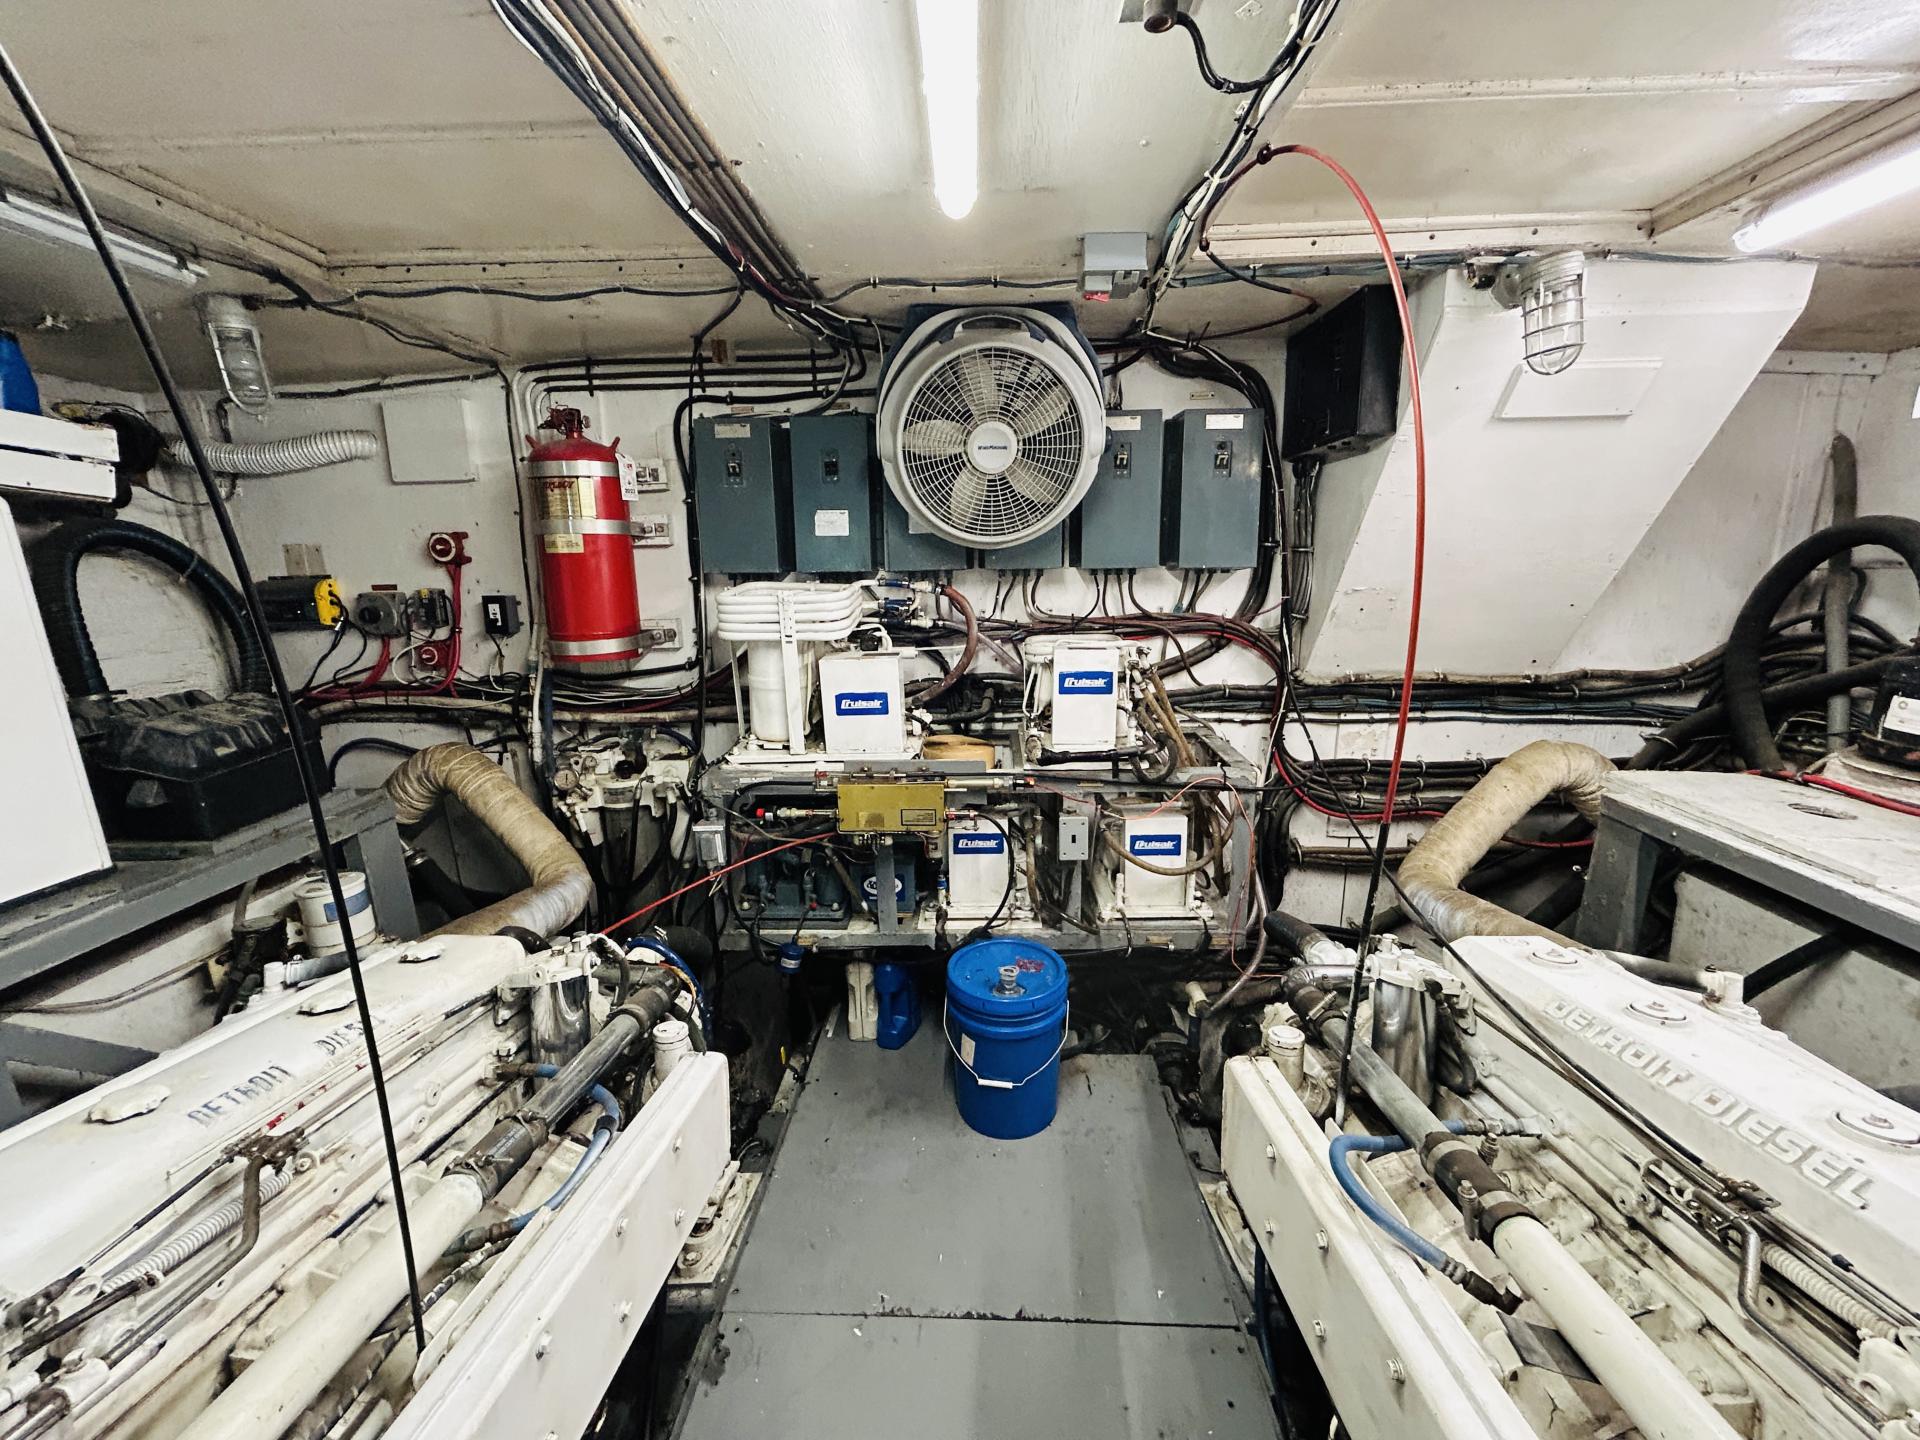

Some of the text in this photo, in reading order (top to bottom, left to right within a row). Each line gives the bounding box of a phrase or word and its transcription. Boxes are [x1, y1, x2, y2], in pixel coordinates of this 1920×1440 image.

[1063, 677, 1107, 688] Cruisair
[840, 699, 883, 710] Cruisair
[958, 838, 999, 848] Cruisair
[1134, 840, 1177, 850] Cruisair
[1544, 999, 1874, 1209] DETROIT DIESEL
